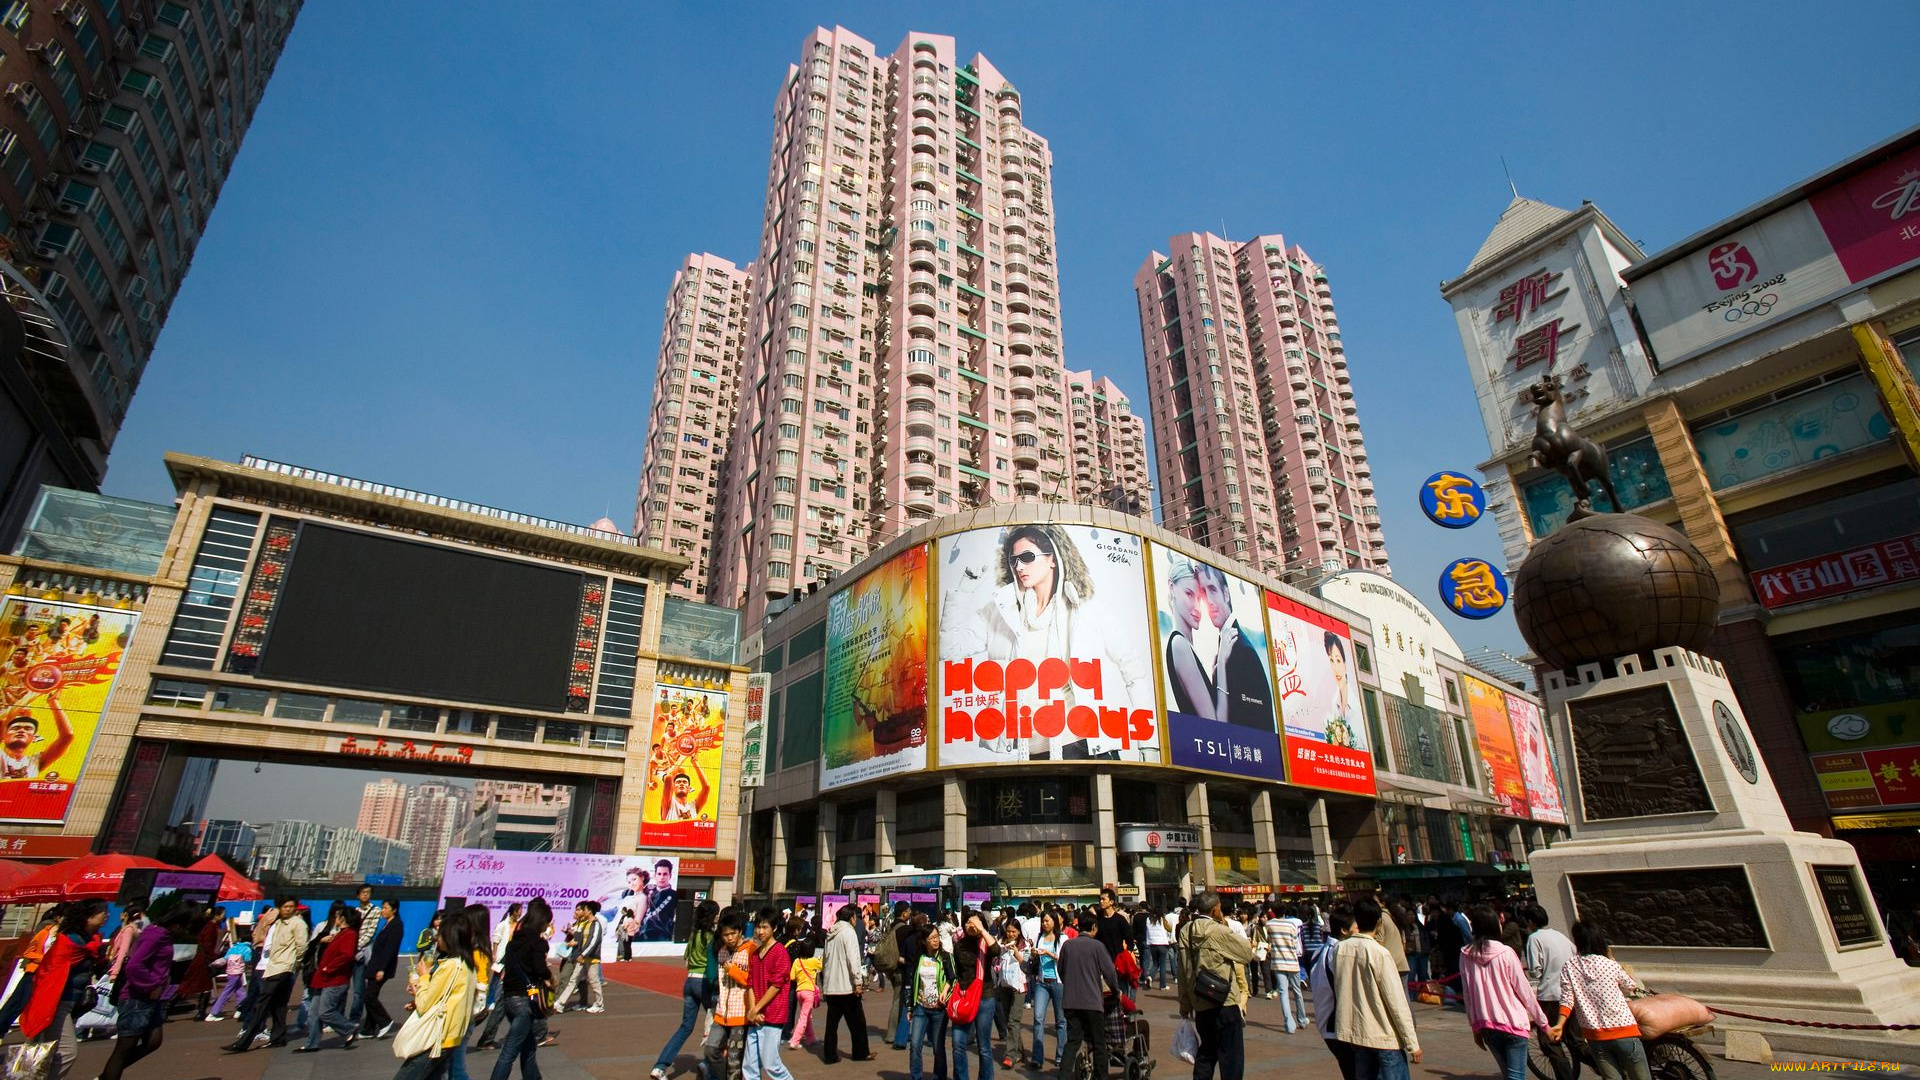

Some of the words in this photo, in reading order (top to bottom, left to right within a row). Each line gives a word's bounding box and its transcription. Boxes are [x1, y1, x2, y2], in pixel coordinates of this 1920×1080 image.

[1702, 290, 1750, 313] Beijing
[1751, 273, 1787, 294] 2008
[1096, 543, 1139, 556] GIORDANO
[945, 657, 1103, 700] Happy
[952, 693, 1000, 709] 节日快乐
[945, 699, 1155, 750] holidays
[1194, 738, 1227, 758] TSL
